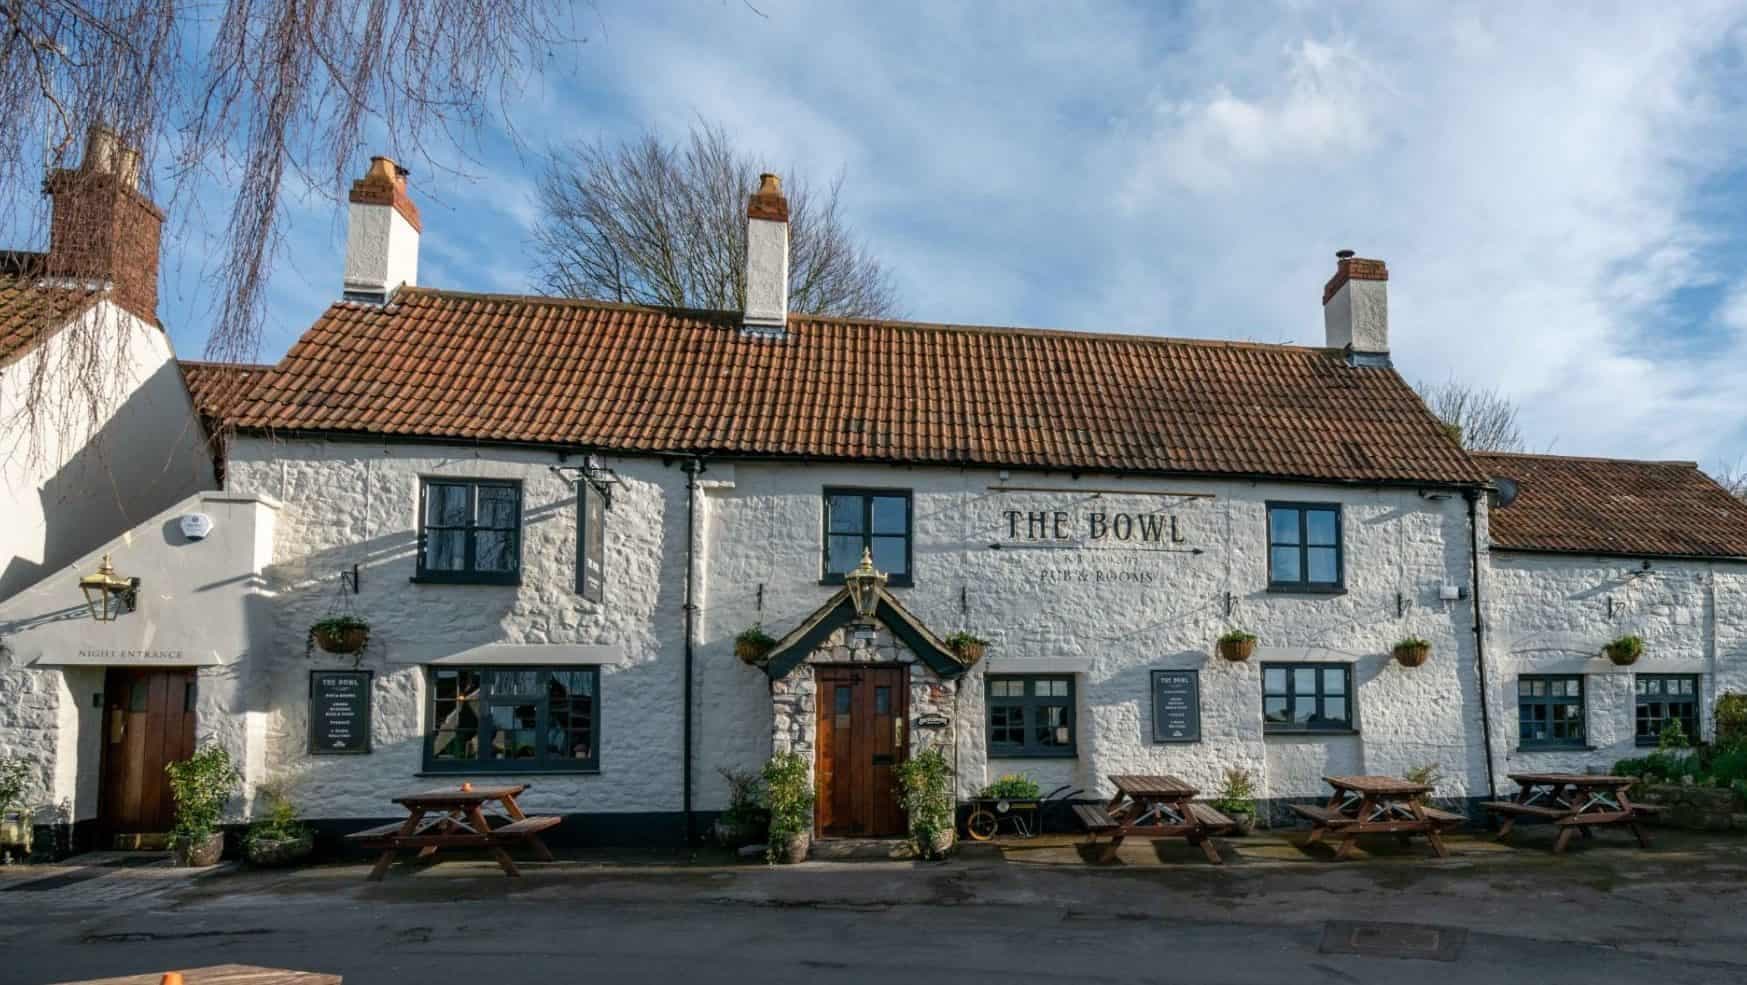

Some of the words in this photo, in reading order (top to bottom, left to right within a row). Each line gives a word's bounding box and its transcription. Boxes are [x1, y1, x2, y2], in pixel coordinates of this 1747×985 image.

[1003, 510, 1069, 539] THE
[1089, 512, 1185, 543] BOWL
[1041, 568, 1072, 582] PUB
[1078, 568, 1089, 582] &
[1096, 569, 1153, 584] ROOMS
[79, 649, 116, 657] NIGHT
[121, 649, 183, 659] ENTRANCE
